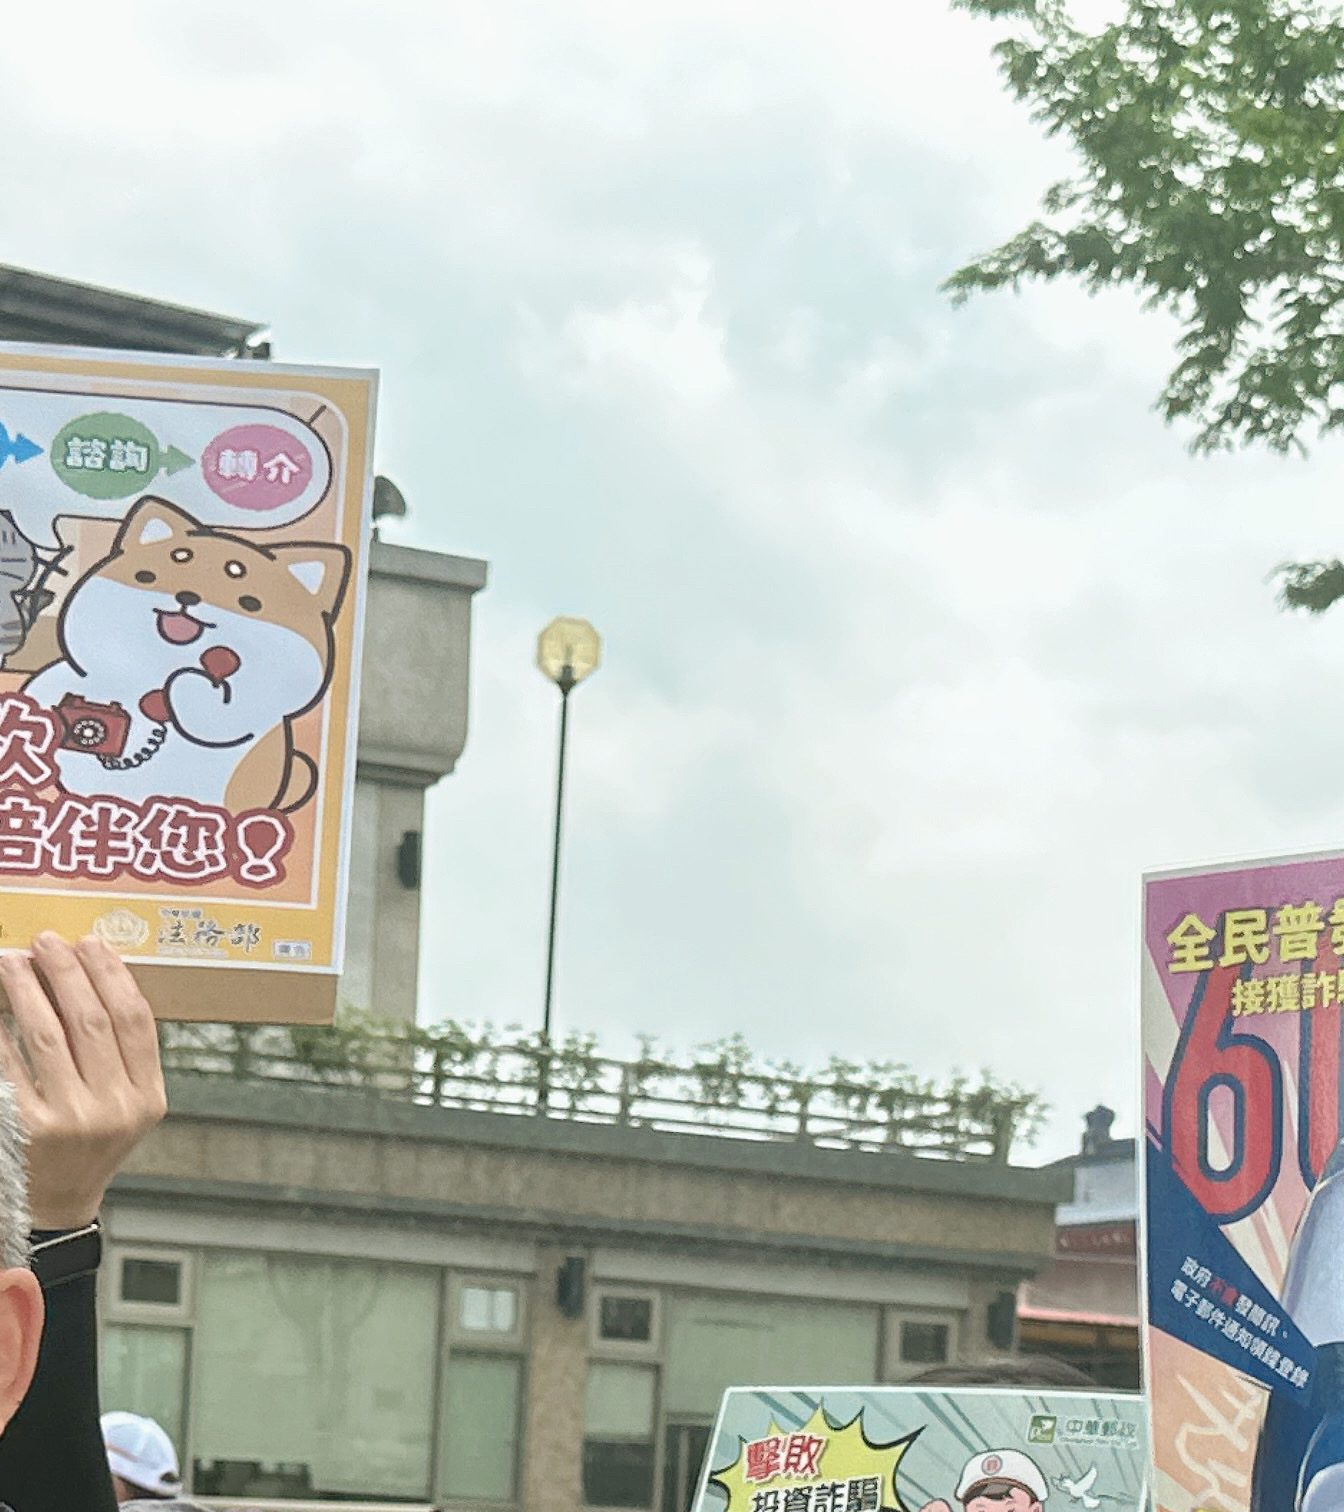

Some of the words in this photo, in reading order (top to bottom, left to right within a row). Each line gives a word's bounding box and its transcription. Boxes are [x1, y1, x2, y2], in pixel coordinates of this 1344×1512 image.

[65, 436, 150, 475] 諮詢
[219, 447, 301, 485] 轉介
[746, 1433, 824, 1481] 擊敗
